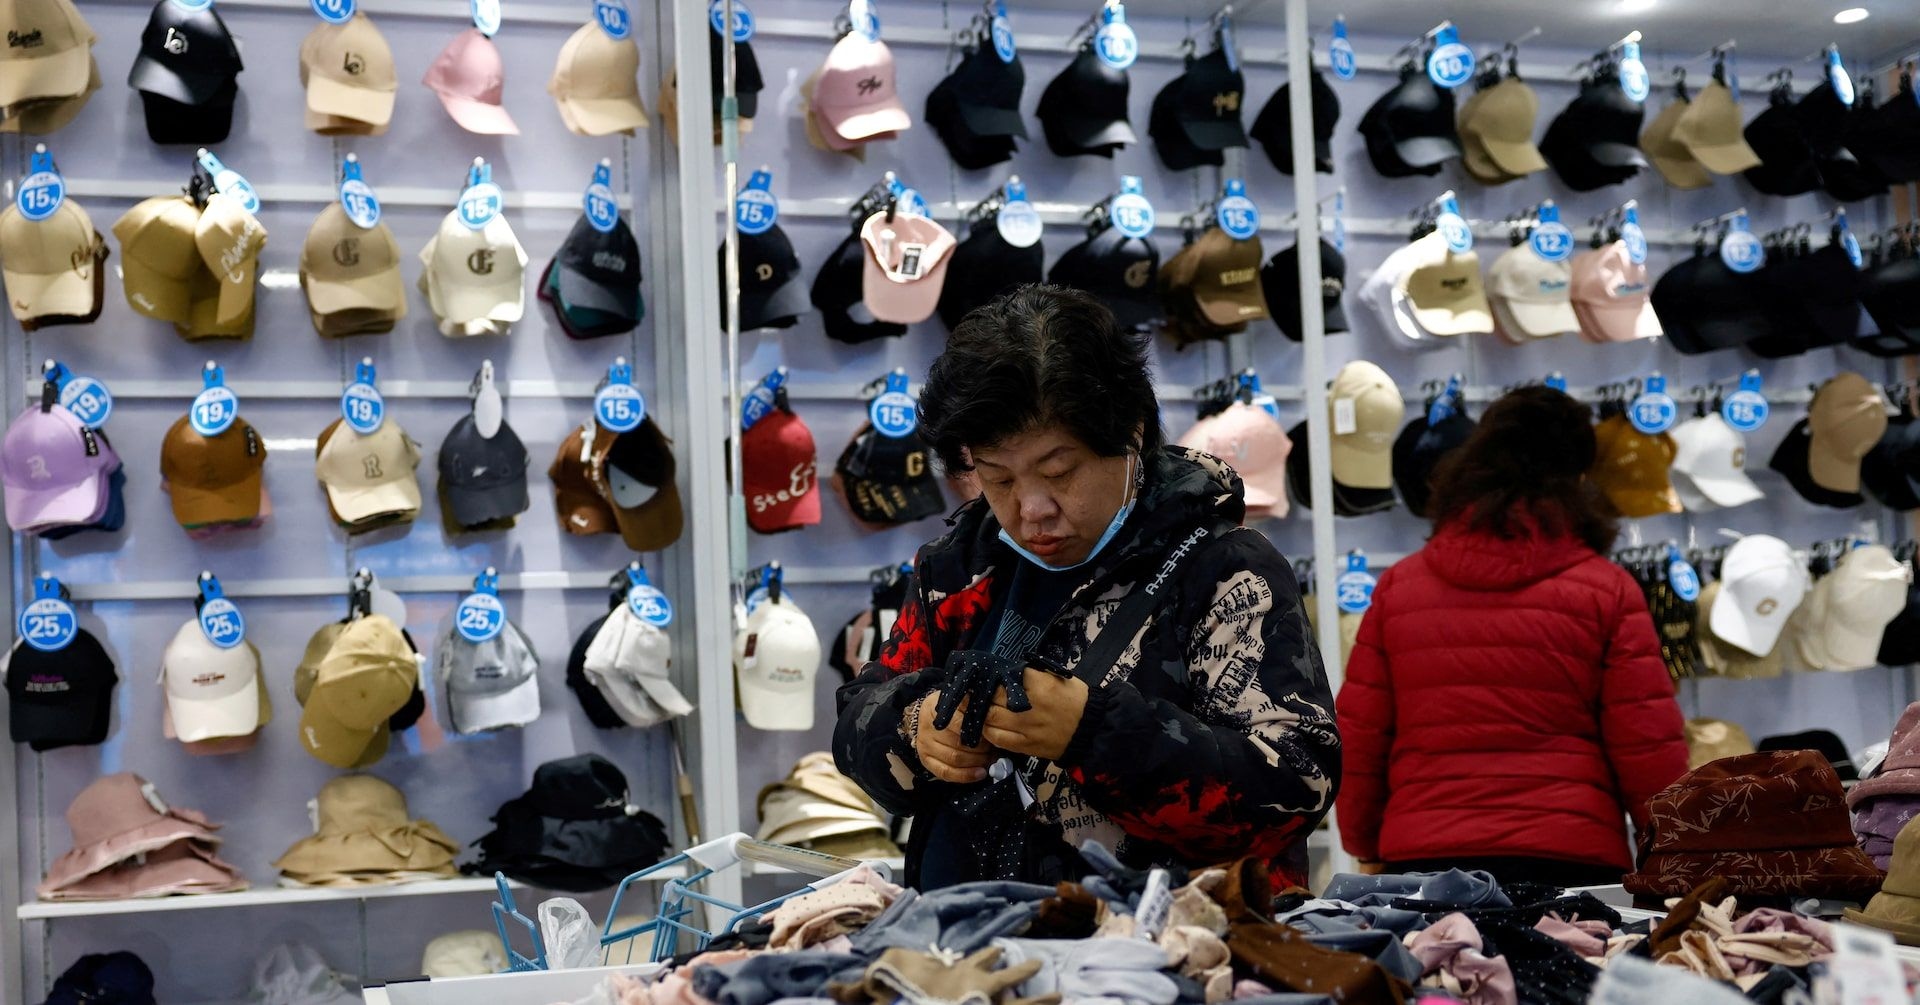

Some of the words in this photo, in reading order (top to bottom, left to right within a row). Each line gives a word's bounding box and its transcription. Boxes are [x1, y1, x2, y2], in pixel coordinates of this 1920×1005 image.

[198, 401, 224, 425] 19
[349, 398, 372, 420] 19
[604, 399, 630, 420] 15
[880, 406, 905, 426] 15
[29, 615, 60, 638] 25
[208, 616, 233, 639] 25
[462, 607, 489, 630] 25
